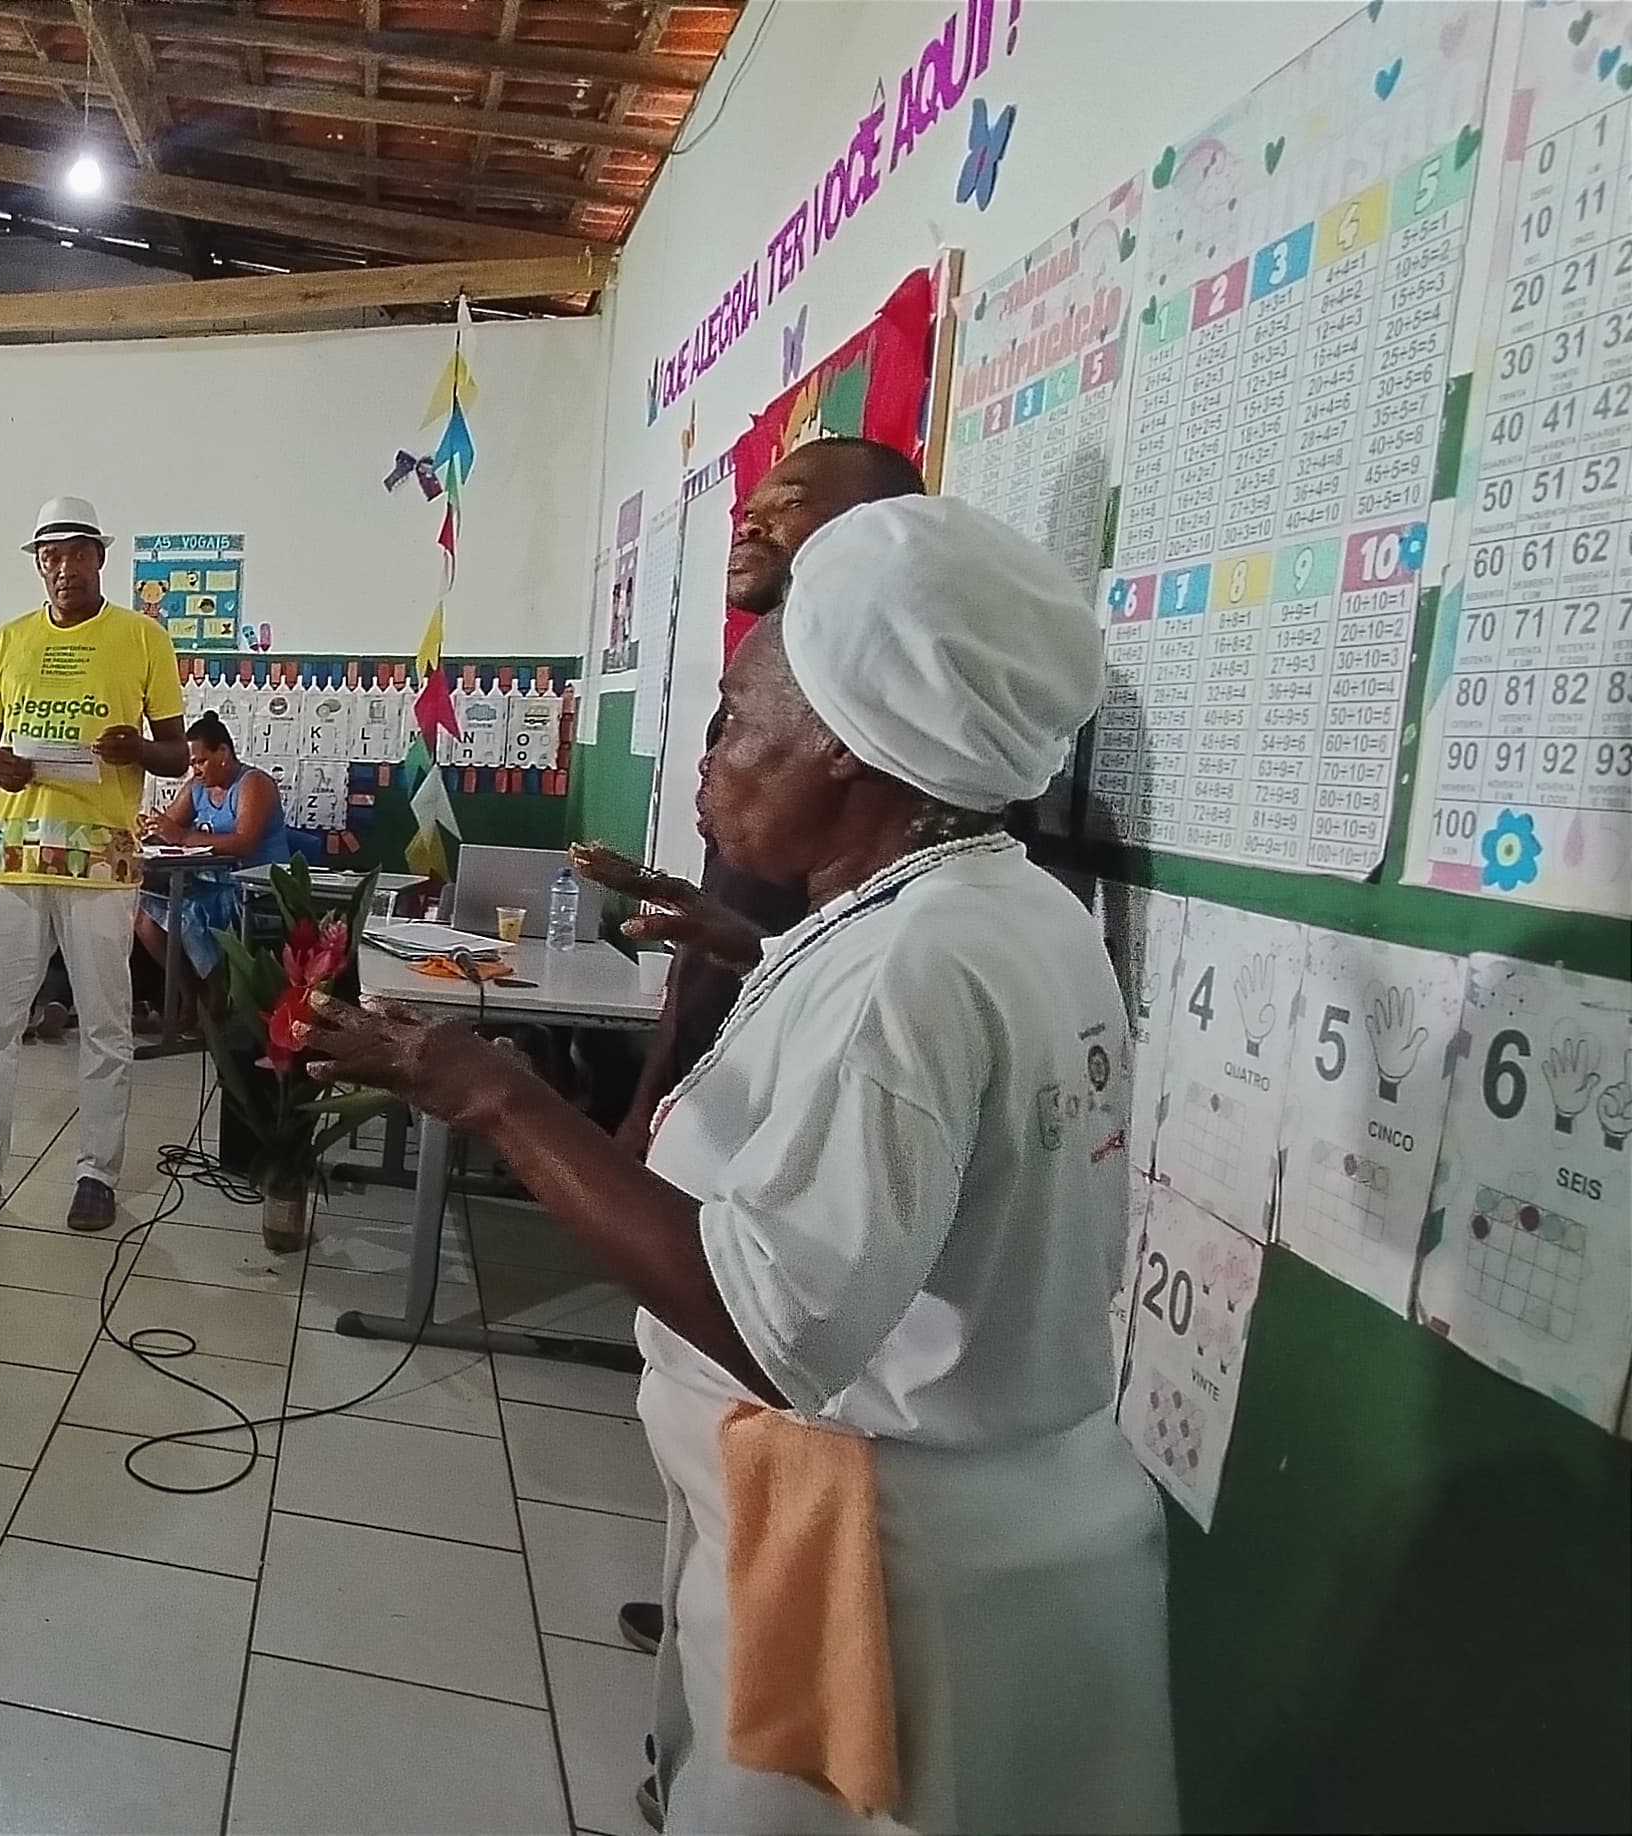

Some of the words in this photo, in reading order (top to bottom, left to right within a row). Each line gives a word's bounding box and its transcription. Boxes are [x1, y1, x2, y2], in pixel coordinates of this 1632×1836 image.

[1593, 114, 1607, 147] 1
[1538, 140, 1556, 175] 0
[1414, 155, 1442, 216] 5
[1575, 180, 1606, 222] 11
[689, 259, 759, 385] ALEGRIA
[767, 200, 808, 306] TER
[813, 75, 886, 256] VOCÊ
[1336, 201, 1360, 251] 4
[1520, 204, 1553, 244] 10
[1268, 241, 1288, 285] 3
[1560, 252, 1598, 295] 21
[1208, 273, 1229, 317] 2
[1509, 273, 1545, 314] 20
[1158, 301, 1169, 342] 1
[1500, 342, 1534, 380] 30
[1551, 324, 1586, 365] 31
[1090, 351, 1104, 384] 5
[991, 403, 1003, 431] 2
[1023, 387, 1035, 417] 3
[1541, 395, 1576, 433] 41
[1592, 381, 1632, 421] 42
[1489, 410, 1524, 445] 40
[1531, 466, 1565, 503] 51
[1581, 455, 1621, 494] 52
[1482, 478, 1513, 513] 50
[153, 536, 171, 550] AS
[182, 535, 230, 550] VOGAIS
[1360, 532, 1401, 583] 10
[1522, 536, 1555, 572] 61
[1572, 528, 1611, 565] 62
[1293, 546, 1314, 594] 9
[1473, 545, 1505, 579] 60
[1175, 570, 1192, 612] 7
[1229, 559, 1249, 604] 8
[1124, 582, 1138, 618] 6
[1466, 611, 1496, 643] 70
[1515, 606, 1544, 640] 71
[1564, 601, 1601, 636] 72
[1455, 676, 1487, 707] 80
[1503, 673, 1536, 706] 81
[1551, 671, 1589, 705] 82
[20, 720, 80, 740] Bahia
[263, 724, 272, 736] J
[310, 726, 321, 739] K
[361, 727, 371, 740] L
[463, 731, 474, 744] N
[311, 742, 320, 754] k
[462, 749, 473, 759] n
[1447, 741, 1478, 771] 90
[1494, 741, 1527, 772] 91
[1541, 742, 1578, 775] 92
[1594, 743, 1632, 777] 93
[307, 796, 318, 809] Z
[307, 812, 317, 822] z
[1433, 807, 1477, 840] 100
[1188, 964, 1216, 1032] 4
[1314, 1004, 1351, 1083] 5
[1223, 1060, 1271, 1093] QUATRO
[1482, 1028, 1532, 1120] 6
[1367, 1119, 1415, 1153] CINCO
[1555, 1166, 1603, 1202] SEIS
[1142, 1251, 1193, 1337] 20
[1191, 1365, 1221, 1402] VINTE
